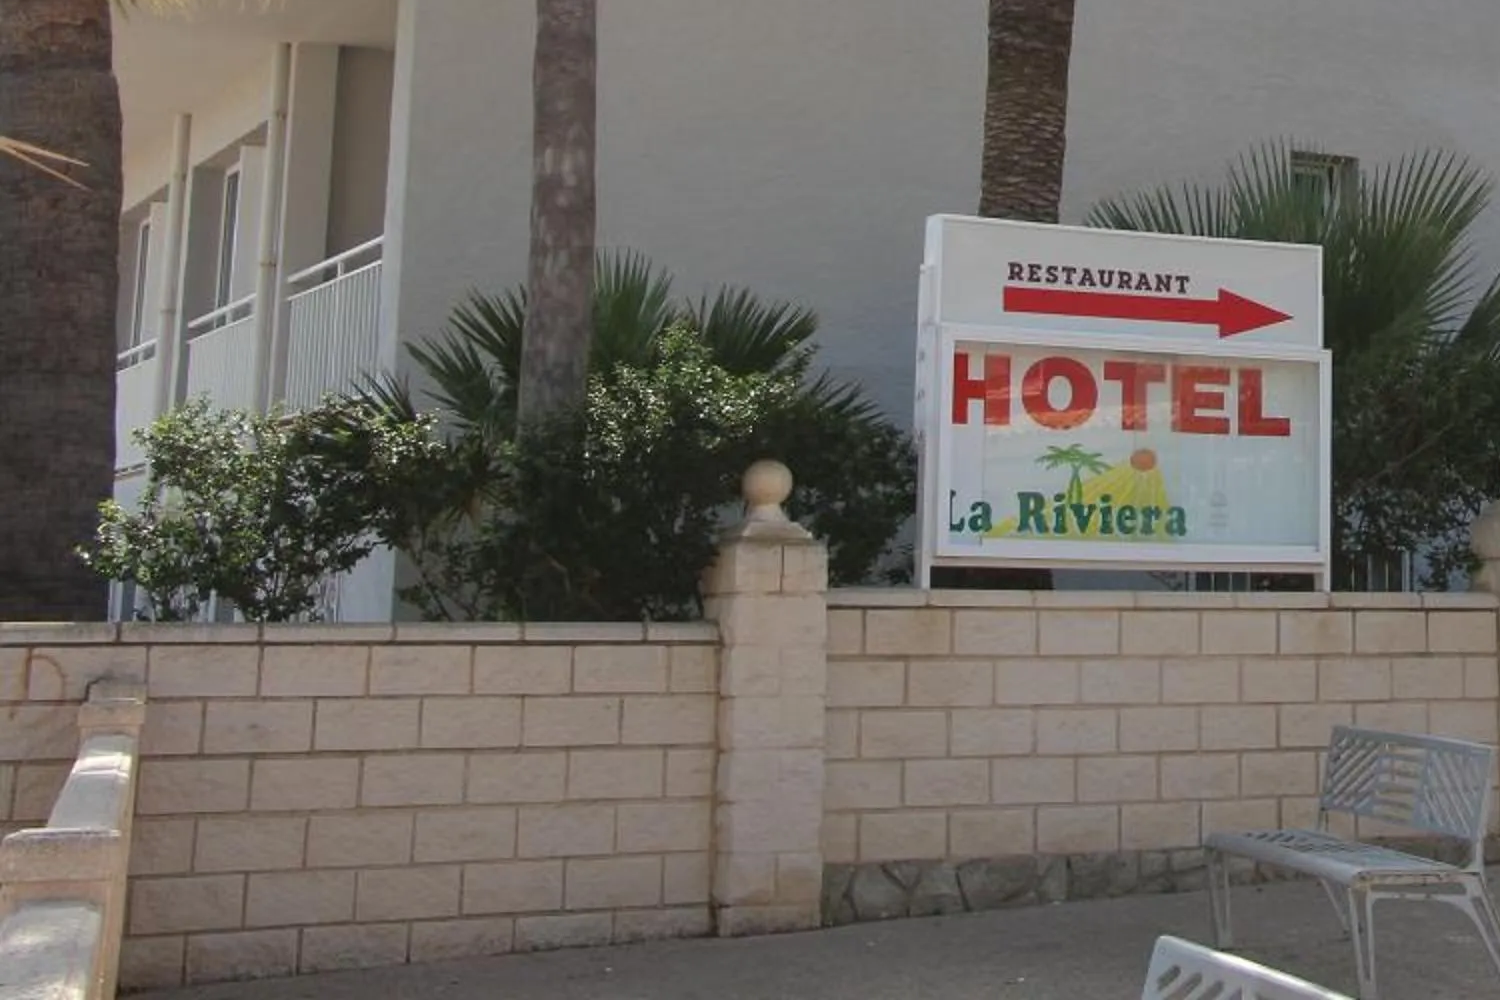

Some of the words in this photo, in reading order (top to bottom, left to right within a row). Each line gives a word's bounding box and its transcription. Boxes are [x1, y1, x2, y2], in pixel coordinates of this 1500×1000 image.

[1008, 262, 1190, 293] RESTAURANT
[952, 353, 1291, 437] HOTEL
[1017, 491, 1187, 537] Riviera
